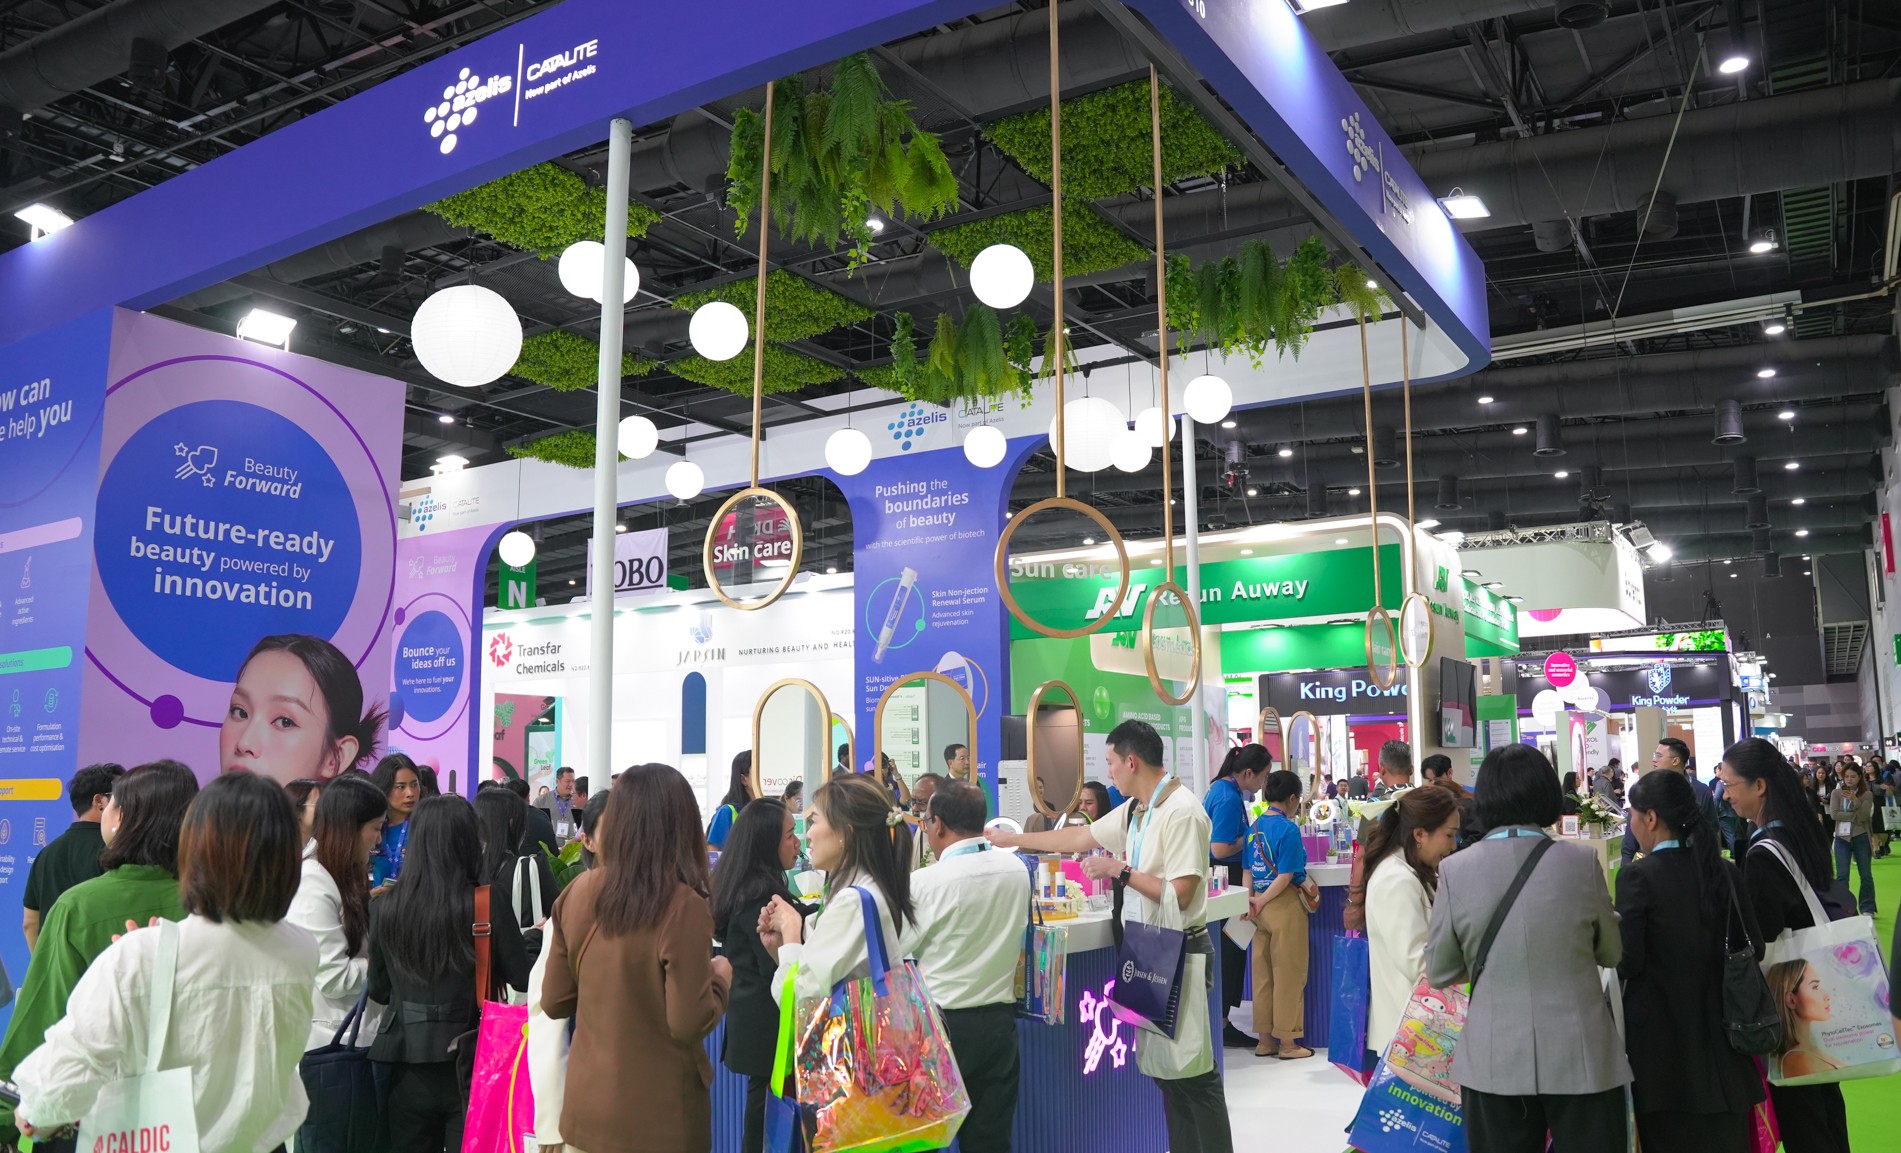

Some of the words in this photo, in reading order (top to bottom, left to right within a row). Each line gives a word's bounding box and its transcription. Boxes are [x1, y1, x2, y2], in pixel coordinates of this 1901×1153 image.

[452, 75, 512, 112] azelis
[527, 39, 599, 81] CATALITE
[525, 86, 543, 100] Now
[544, 78, 562, 94] part
[562, 73, 572, 86] of
[572, 64, 597, 81] Azelis
[20, 378, 50, 406] can
[8, 413, 36, 439] help
[38, 400, 72, 438] you
[907, 411, 947, 428] azelis
[958, 422, 971, 430] Now
[972, 420, 983, 428] part
[989, 417, 1004, 425] Azelis
[244, 458, 298, 483] Beauty
[223, 471, 301, 499] Forward
[875, 481, 927, 498] Pushing
[930, 479, 948, 491] the
[423, 502, 447, 513] azelis
[885, 492, 969, 514] boundaries
[896, 518, 906, 529] of
[909, 512, 956, 528] beauty
[145, 506, 335, 563] Future-ready
[866, 541, 880, 550] with
[881, 540, 892, 549] the
[894, 536, 924, 547] scientific
[925, 533, 948, 545] power
[949, 531, 957, 540] of
[958, 529, 985, 540] biotech
[130, 537, 216, 572] beauty
[220, 555, 289, 577] powered
[293, 561, 311, 582] by
[713, 543, 749, 563] Skin
[754, 540, 792, 558] care
[614, 556, 664, 588] OBO
[1010, 557, 1055, 578] Sun
[1062, 563, 1113, 580] care
[153, 567, 313, 610] innovation
[508, 579, 527, 608] N
[932, 589, 947, 598] Skin
[948, 586, 989, 597] Non-jection
[1231, 579, 1308, 600] Auway
[932, 597, 961, 607] Renewal
[962, 596, 986, 605] Serum
[932, 610, 961, 619] Advanced
[961, 608, 974, 617] skin
[932, 618, 969, 628] rejuvenation
[402, 646, 434, 658] Bounce
[435, 647, 451, 658] your
[517, 642, 561, 657] Transfar
[738, 646, 779, 656] NURTURING
[782, 644, 810, 653] BEAUTY
[813, 642, 829, 650] AND
[411, 658, 432, 669] ideas
[433, 656, 445, 668] off
[446, 657, 456, 667] us
[516, 660, 565, 674] Chemicals
[415, 677, 426, 685] here
[442, 676, 454, 685] your
[1300, 681, 1347, 702] King
[1632, 695, 1652, 707] King
[1653, 694, 1690, 705] Powder
[1147, 971, 1152, 981] &
[1388, 1082, 1463, 1127] innovation
[1391, 1115, 1417, 1132] azelis
[107, 1124, 170, 1153] CALDIC
